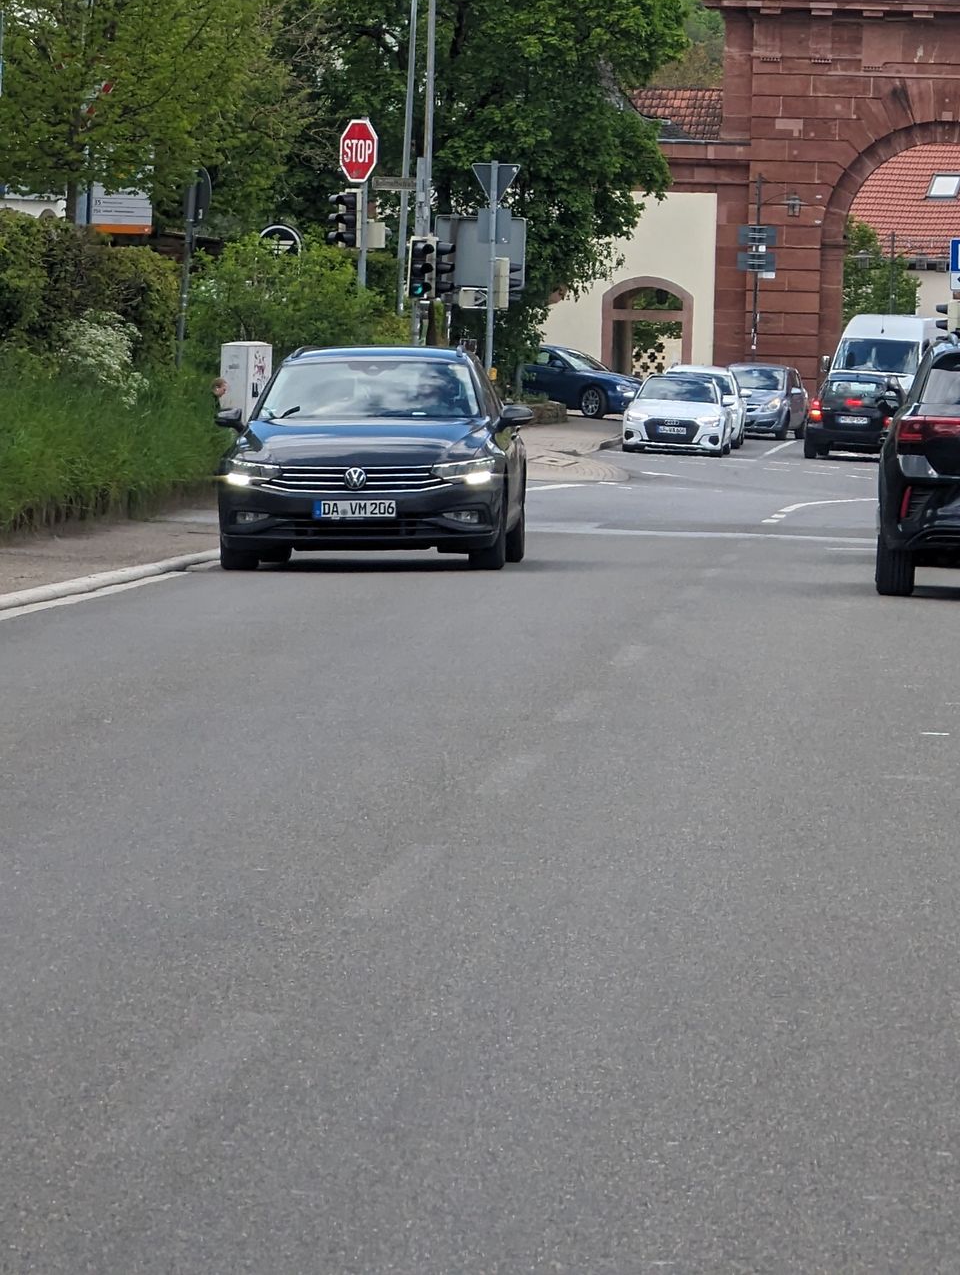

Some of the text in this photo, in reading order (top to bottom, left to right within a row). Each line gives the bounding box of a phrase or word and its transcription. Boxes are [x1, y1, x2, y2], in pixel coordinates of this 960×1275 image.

[343, 139, 373, 163] STOP
[322, 502, 395, 515] DA VM 206
